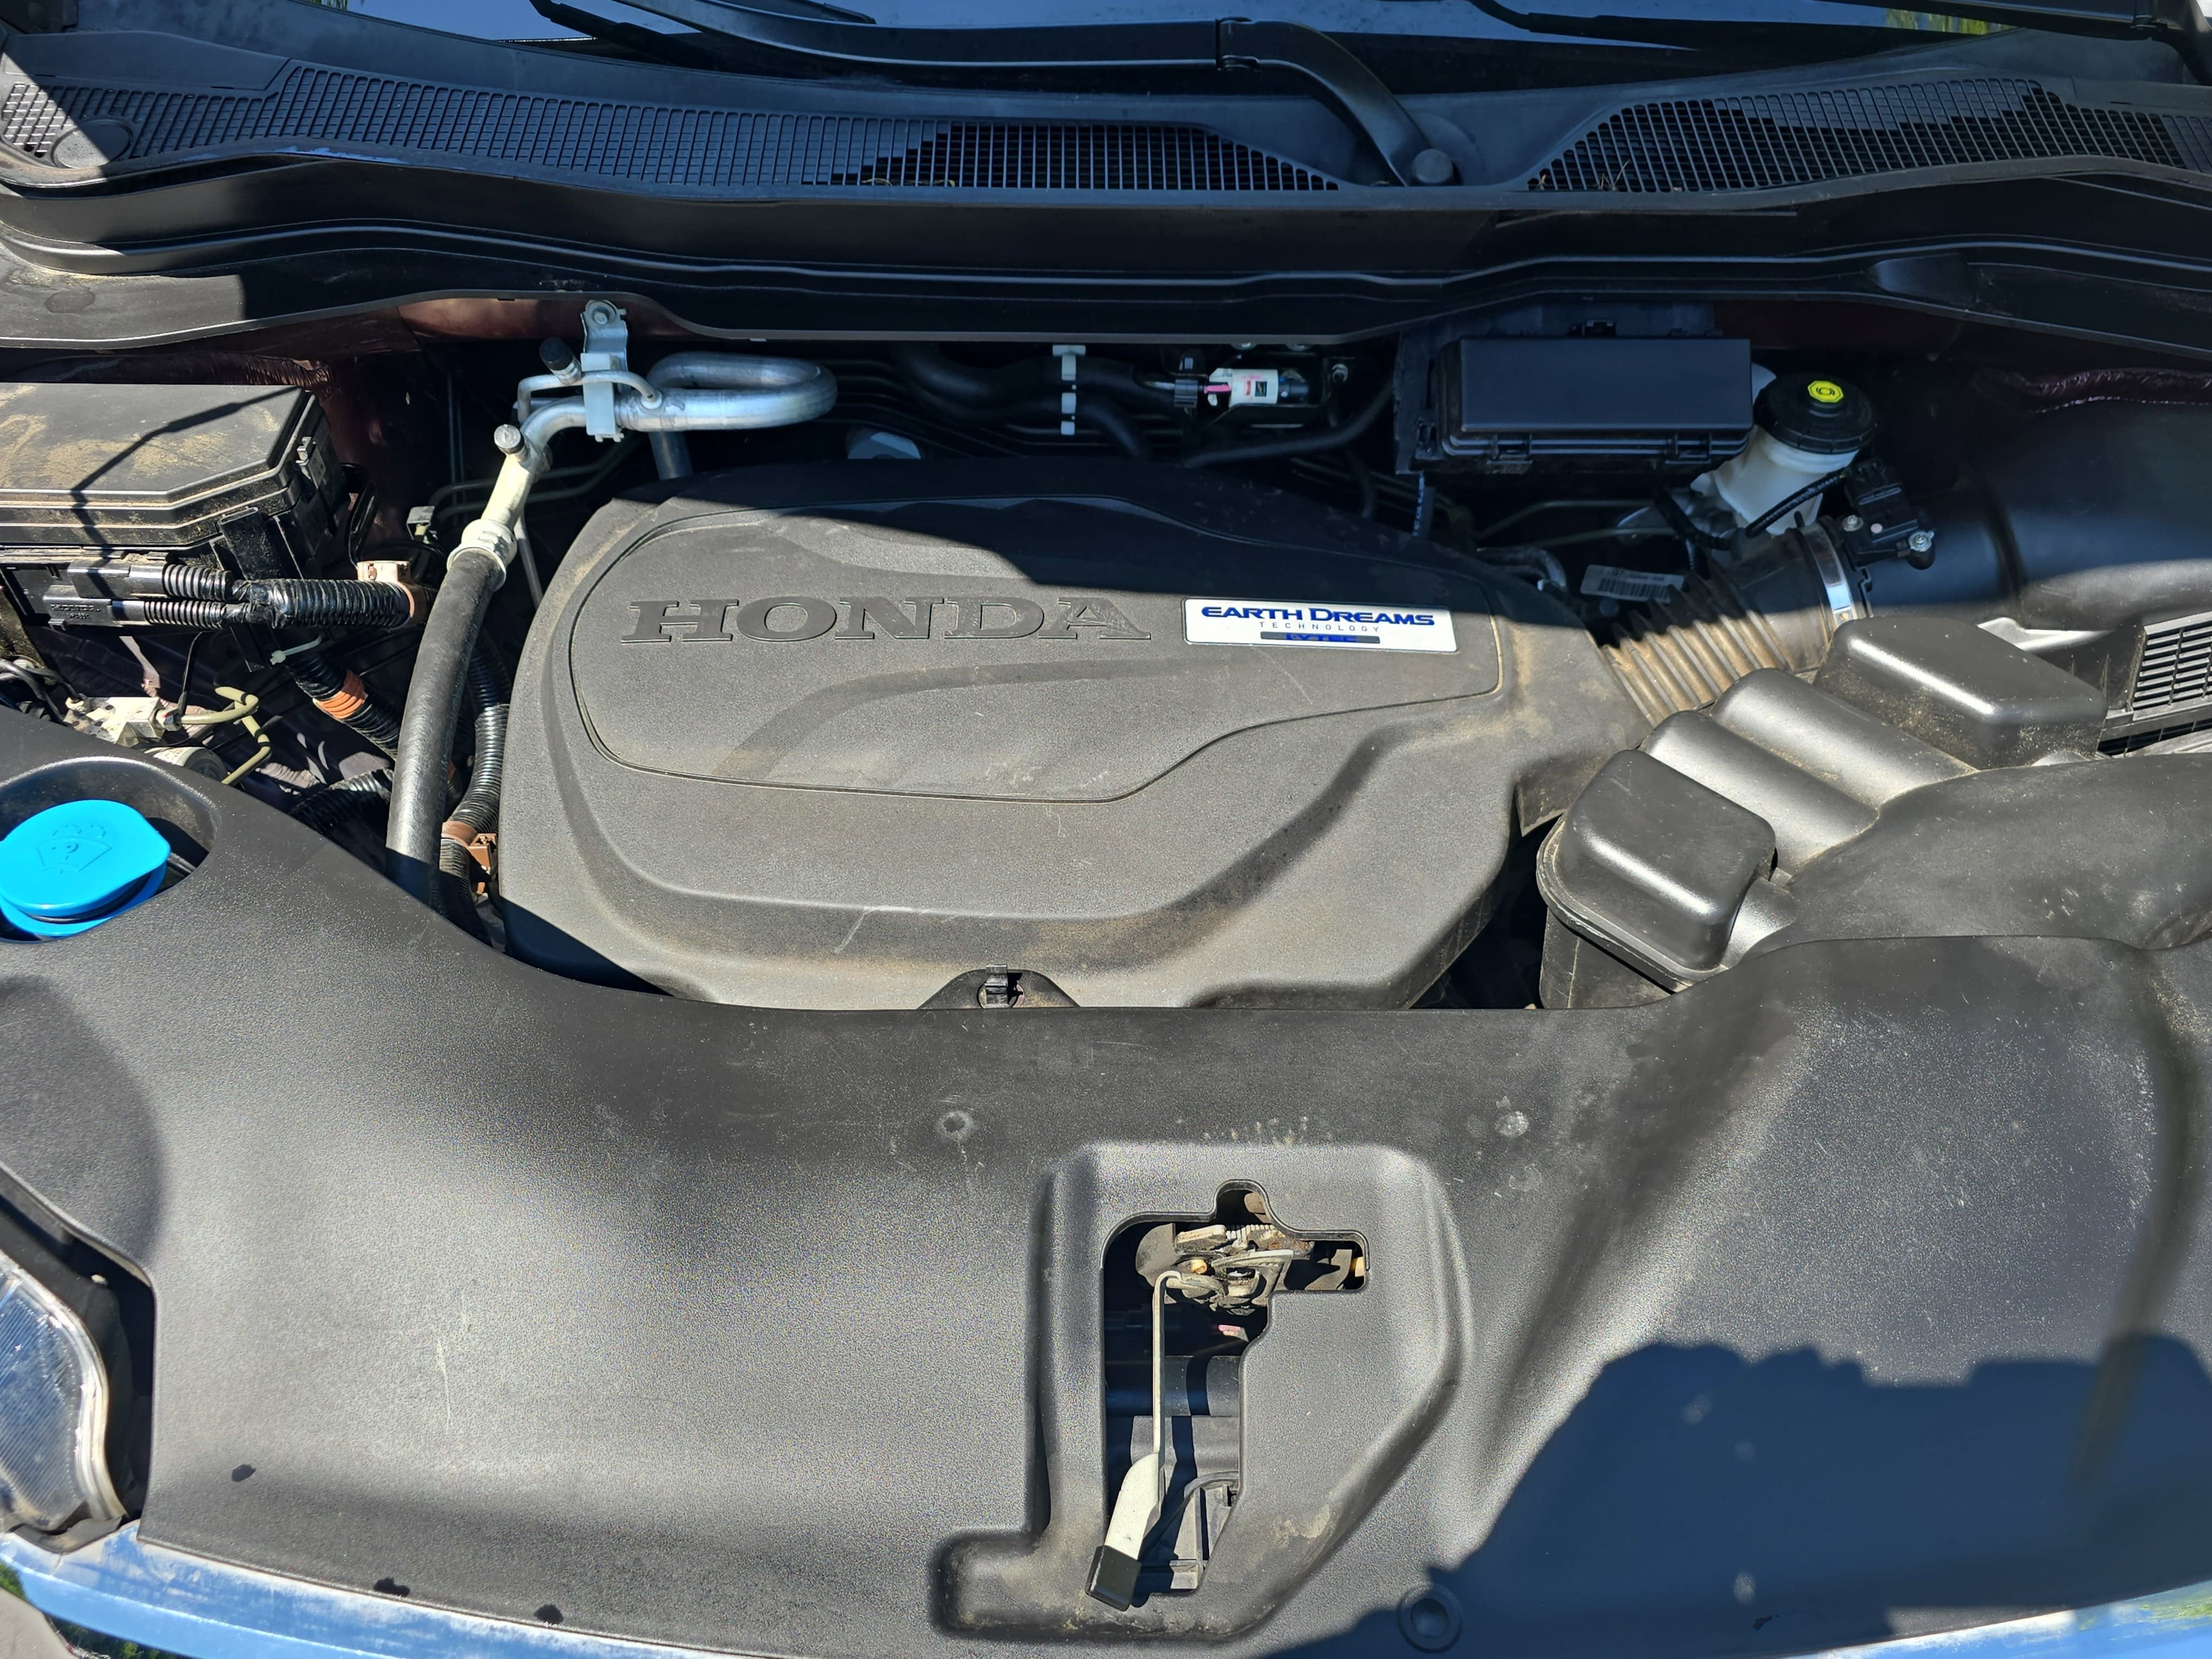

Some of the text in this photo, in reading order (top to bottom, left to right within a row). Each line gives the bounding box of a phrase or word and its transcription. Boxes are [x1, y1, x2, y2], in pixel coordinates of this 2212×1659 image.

[620, 596, 1151, 644] HONDA
[1201, 606, 1435, 626] EARTH DREAMS
[1259, 621, 1380, 632] TECHNOLOGY
